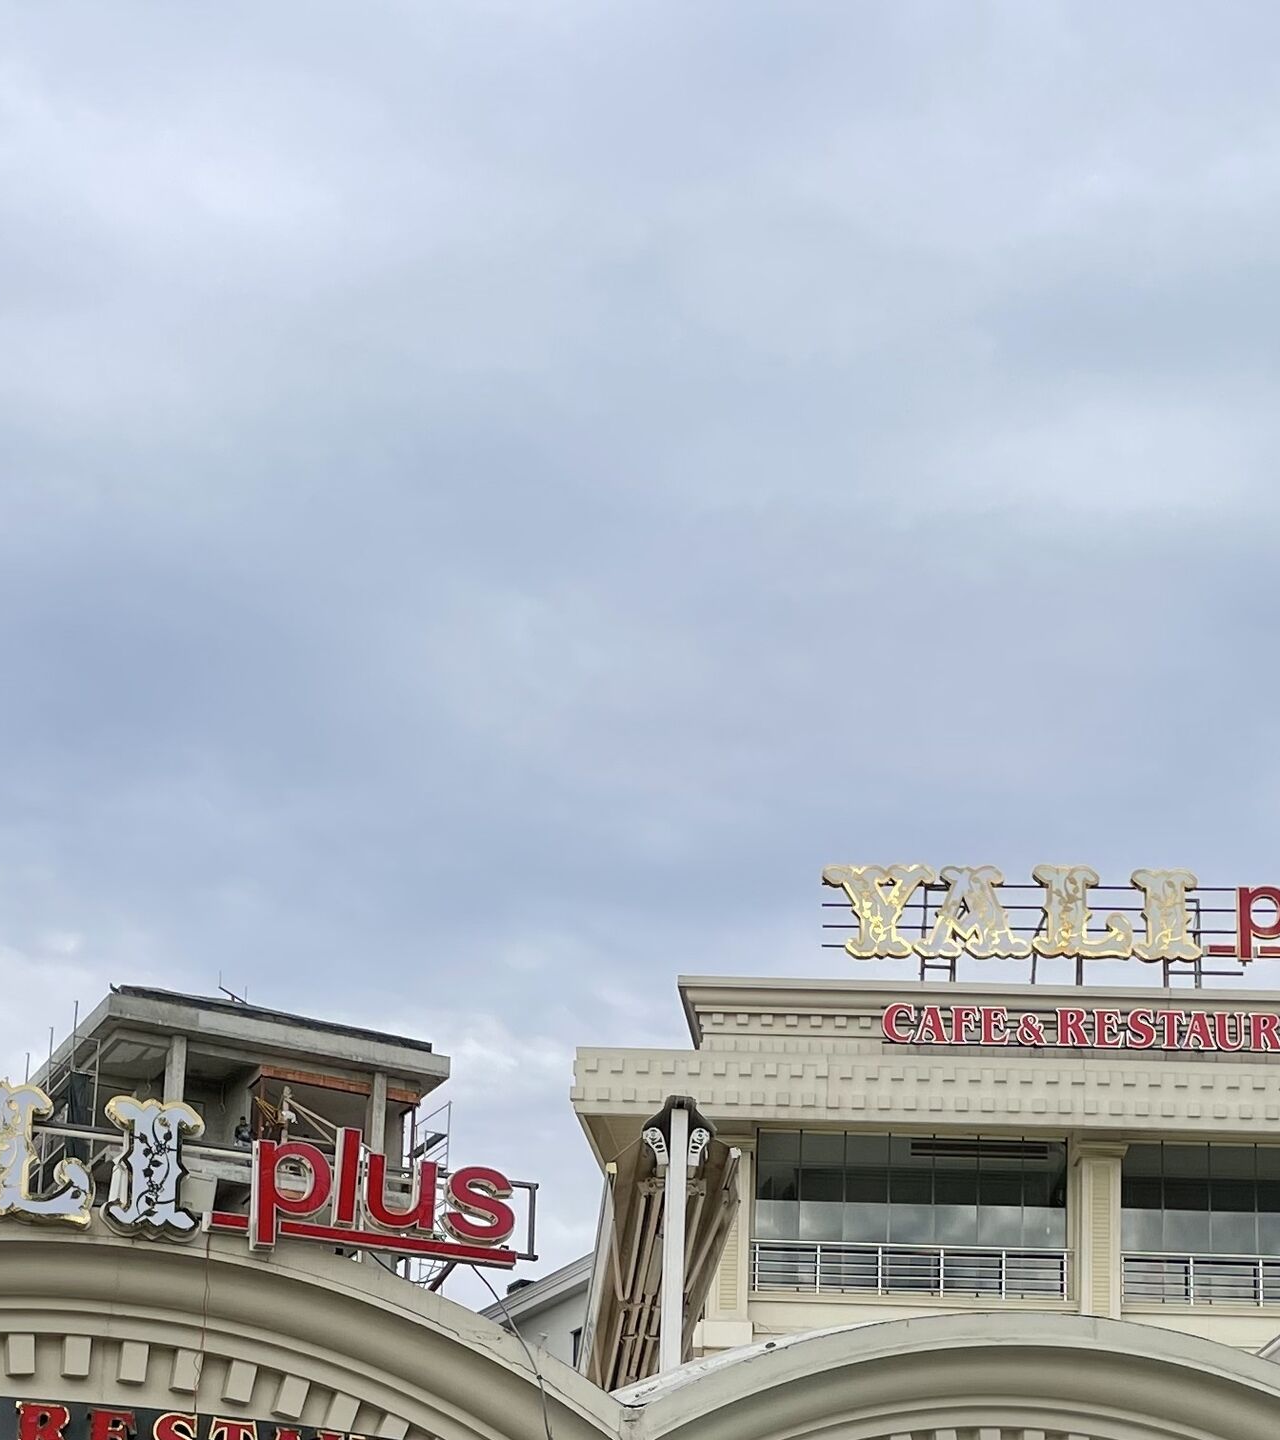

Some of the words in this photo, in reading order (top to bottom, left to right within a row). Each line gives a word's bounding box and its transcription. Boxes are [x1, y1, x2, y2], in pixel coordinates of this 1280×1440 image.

[822, 863, 1202, 962] YALI
[882, 1003, 1010, 1045] CAFE
[1016, 1014, 1045, 1046] &
[249, 1127, 516, 1252] plus
